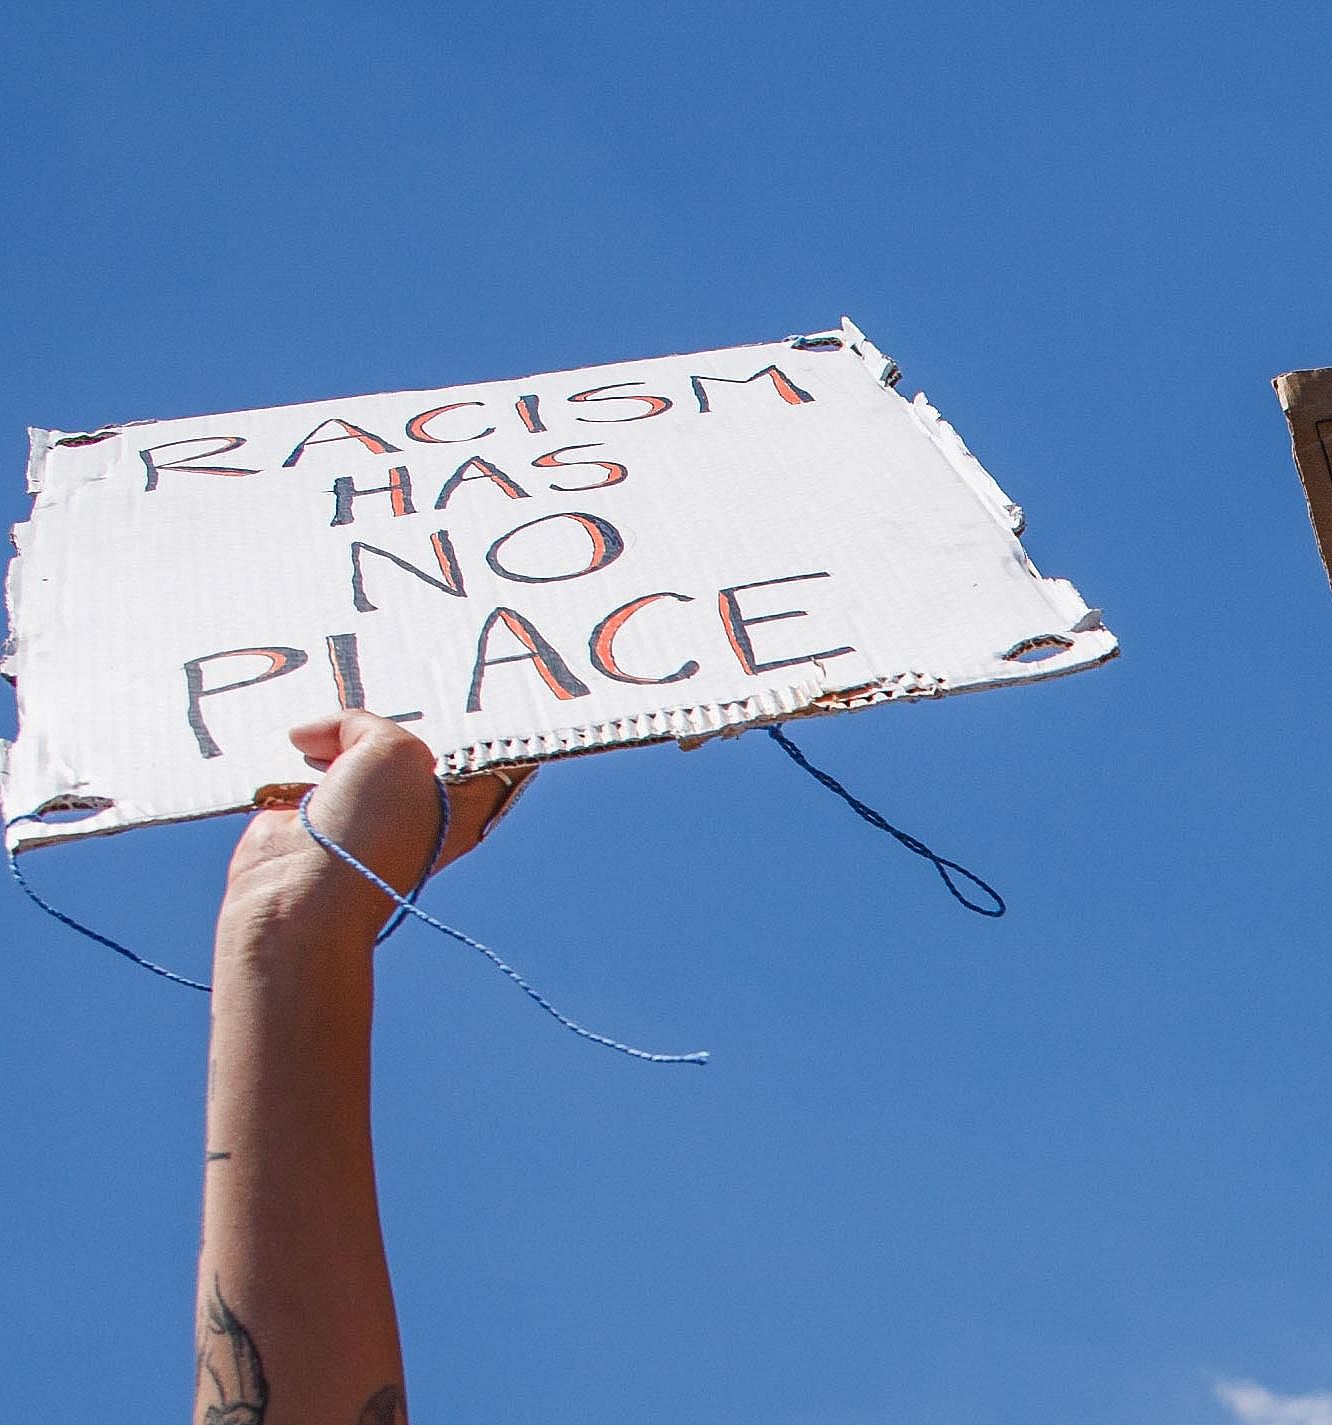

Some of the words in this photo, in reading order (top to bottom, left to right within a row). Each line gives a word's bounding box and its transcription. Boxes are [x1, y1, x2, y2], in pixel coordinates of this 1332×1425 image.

[139, 365, 815, 491] RACISM
[325, 443, 628, 526] HAS
[350, 511, 625, 612] NO
[183, 571, 854, 759] PLACE
